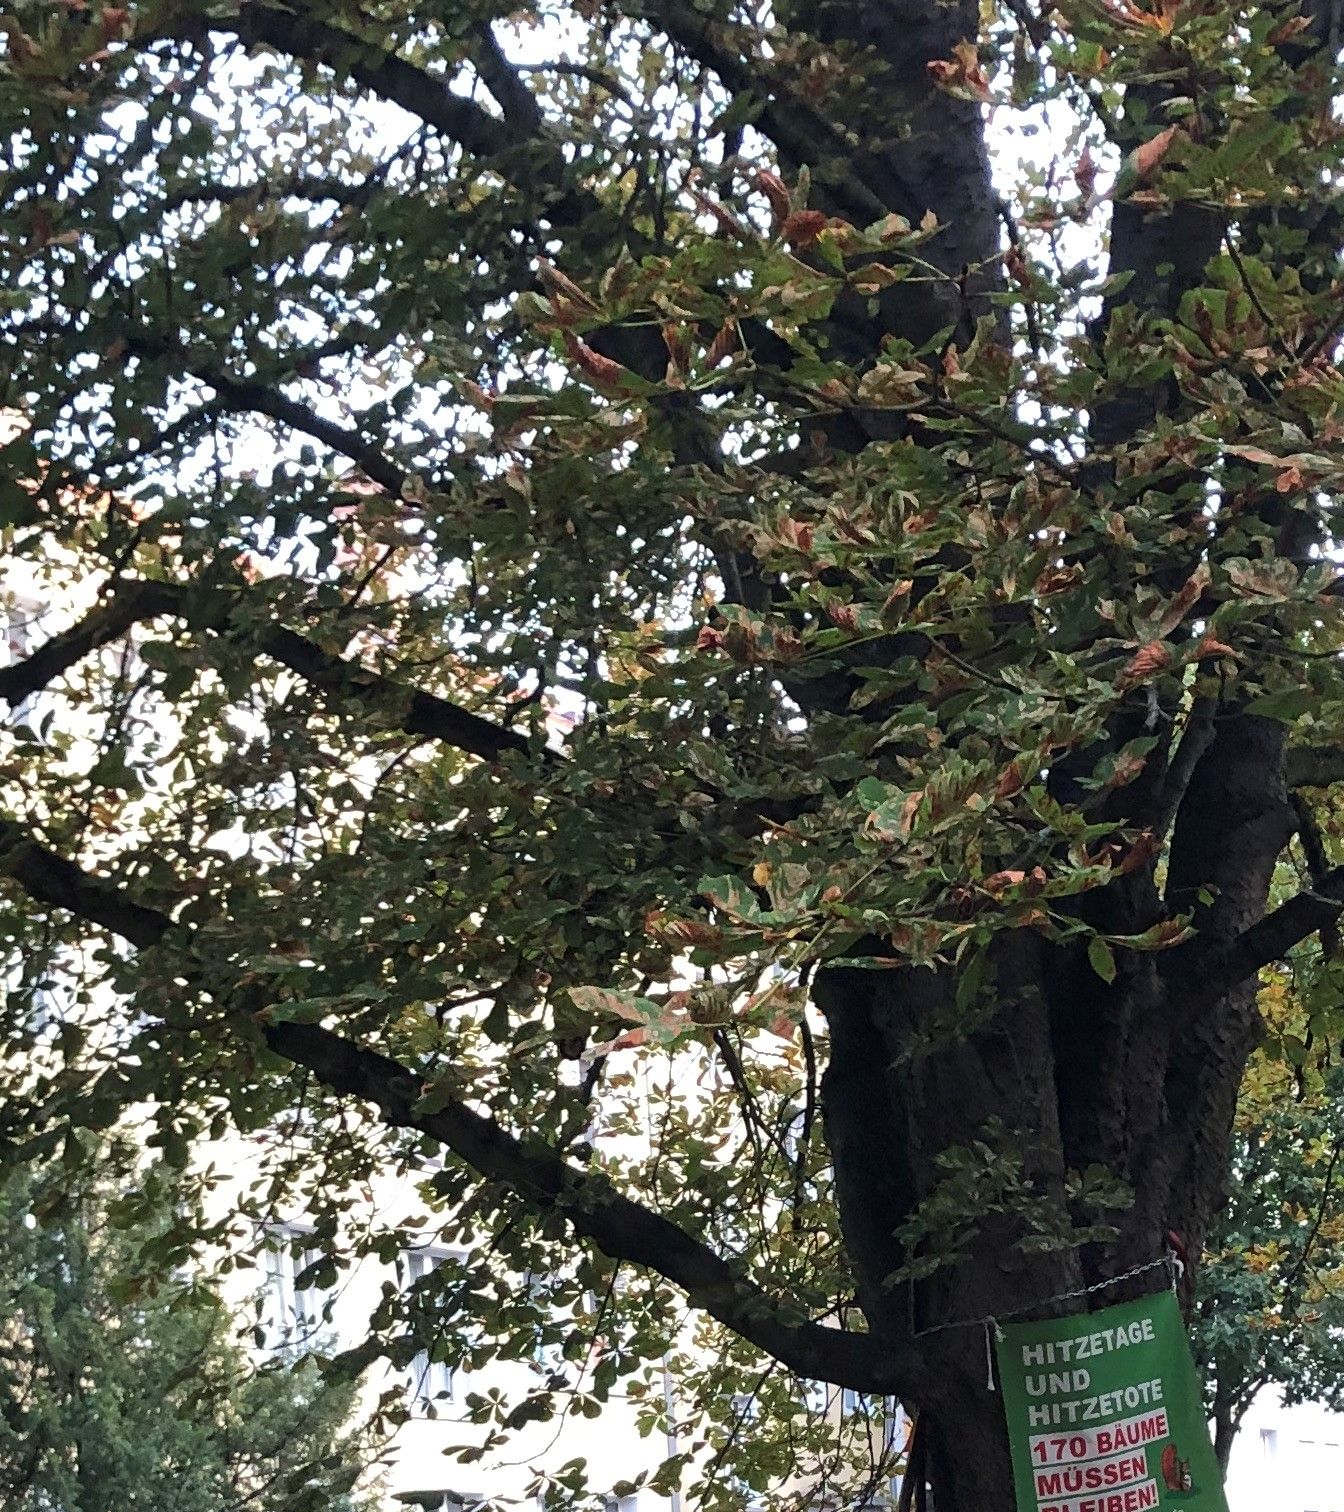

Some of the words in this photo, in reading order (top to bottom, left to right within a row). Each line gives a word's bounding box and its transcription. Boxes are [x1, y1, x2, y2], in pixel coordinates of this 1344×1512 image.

[1022, 1318, 1156, 1366] HITZETAGE
[1025, 1368, 1091, 1396] UND
[1028, 1378, 1164, 1427] HITZETOTE
[1033, 1436, 1087, 1463] 170
[1096, 1414, 1168, 1454] BÄUME
[1037, 1455, 1146, 1497] MÜSSEN
